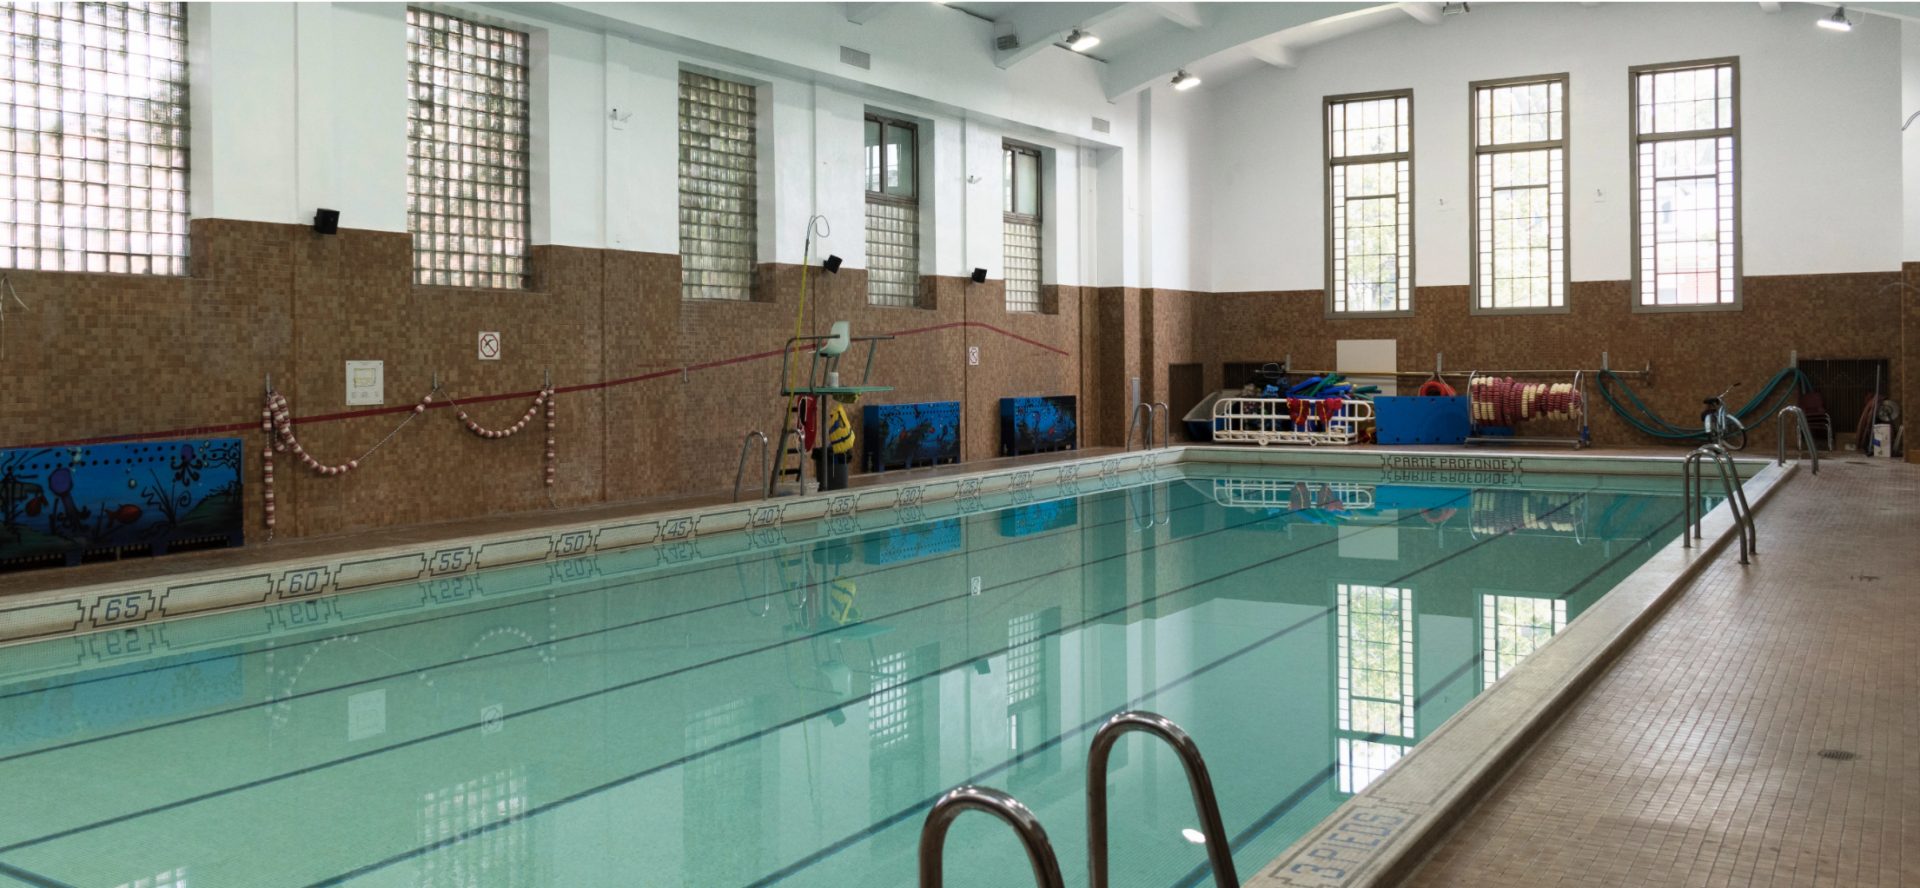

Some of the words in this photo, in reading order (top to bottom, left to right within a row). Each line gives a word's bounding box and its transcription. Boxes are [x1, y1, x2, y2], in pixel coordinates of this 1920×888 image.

[1394, 456, 1436, 469] PARTIE
[1440, 458, 1509, 470] PROFONDE
[903, 489, 917, 503] 30
[835, 498, 851, 513] 35
[757, 509, 774, 523] 40
[667, 521, 687, 536] 45
[563, 535, 584, 553] 50
[439, 551, 465, 571] 55
[290, 571, 318, 593] 60
[105, 595, 141, 621] 65
[1307, 811, 1405, 865] PIEDS
[1290, 862, 1346, 880] 3
